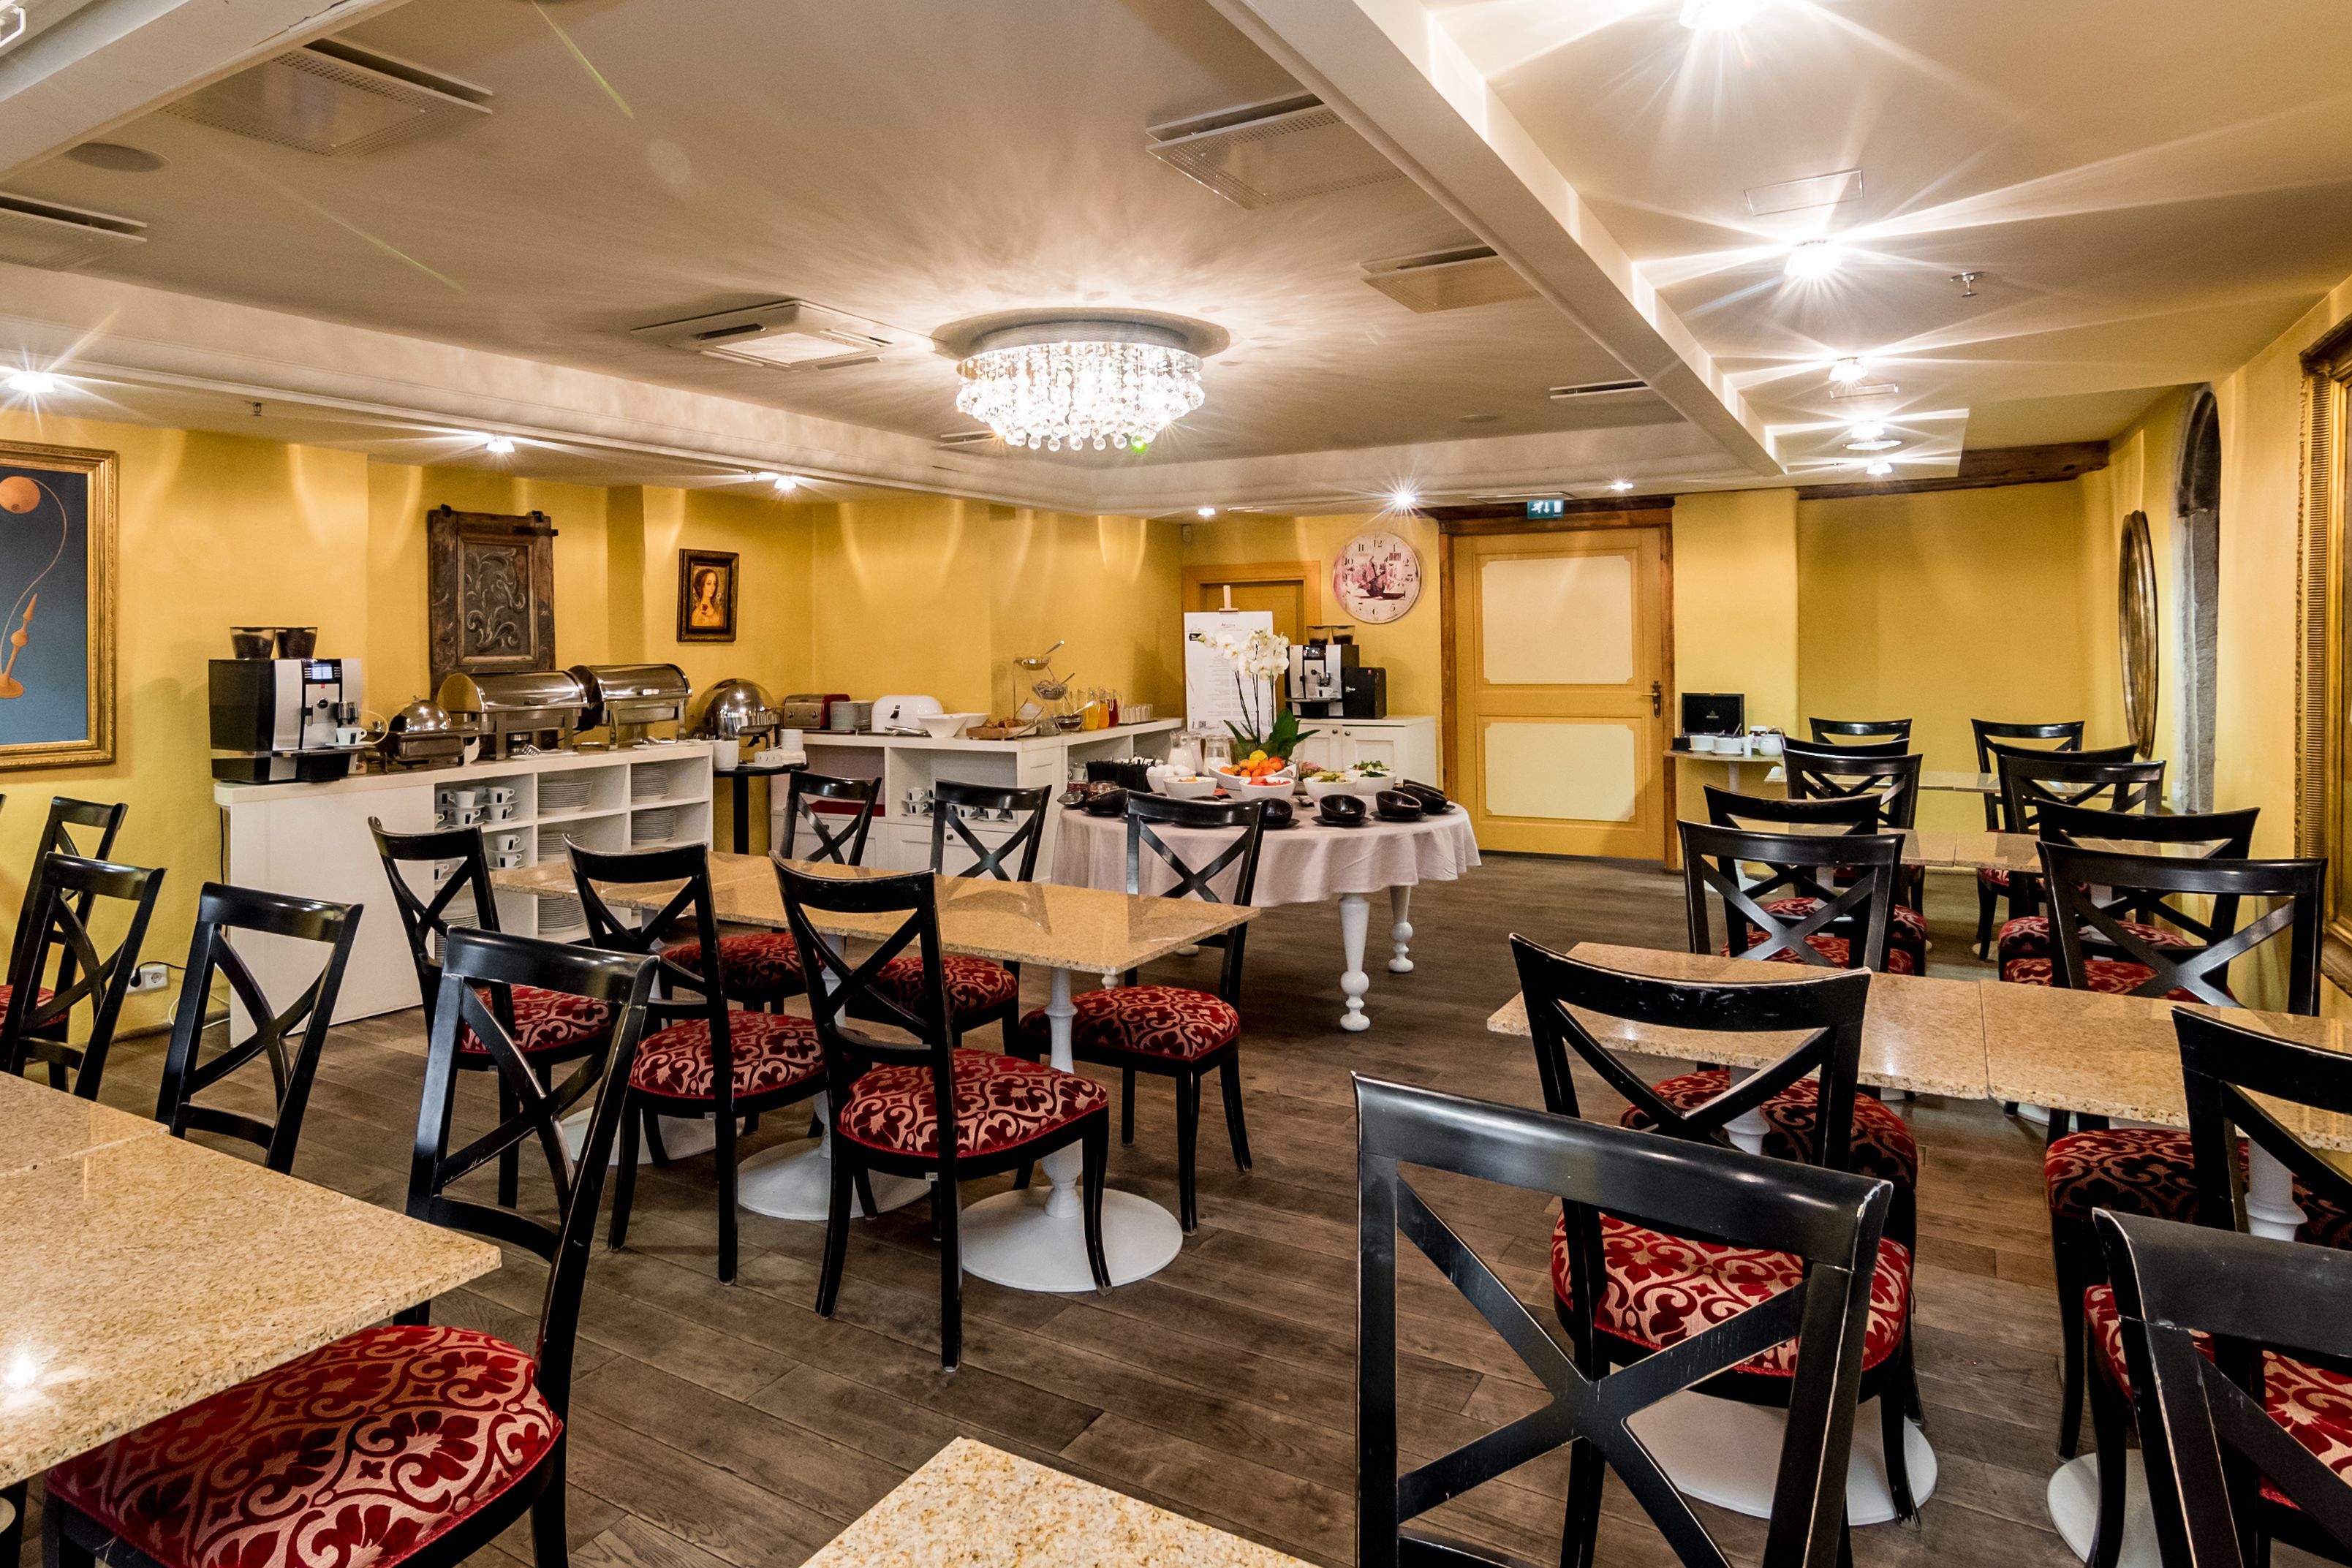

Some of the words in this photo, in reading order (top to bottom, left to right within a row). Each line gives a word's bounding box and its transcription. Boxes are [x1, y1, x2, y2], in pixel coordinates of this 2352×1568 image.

[1374, 539, 1383, 548] 12
[1358, 544, 1364, 552] 11
[1345, 558, 1353, 566] 10
[1404, 574, 1413, 583] 3
